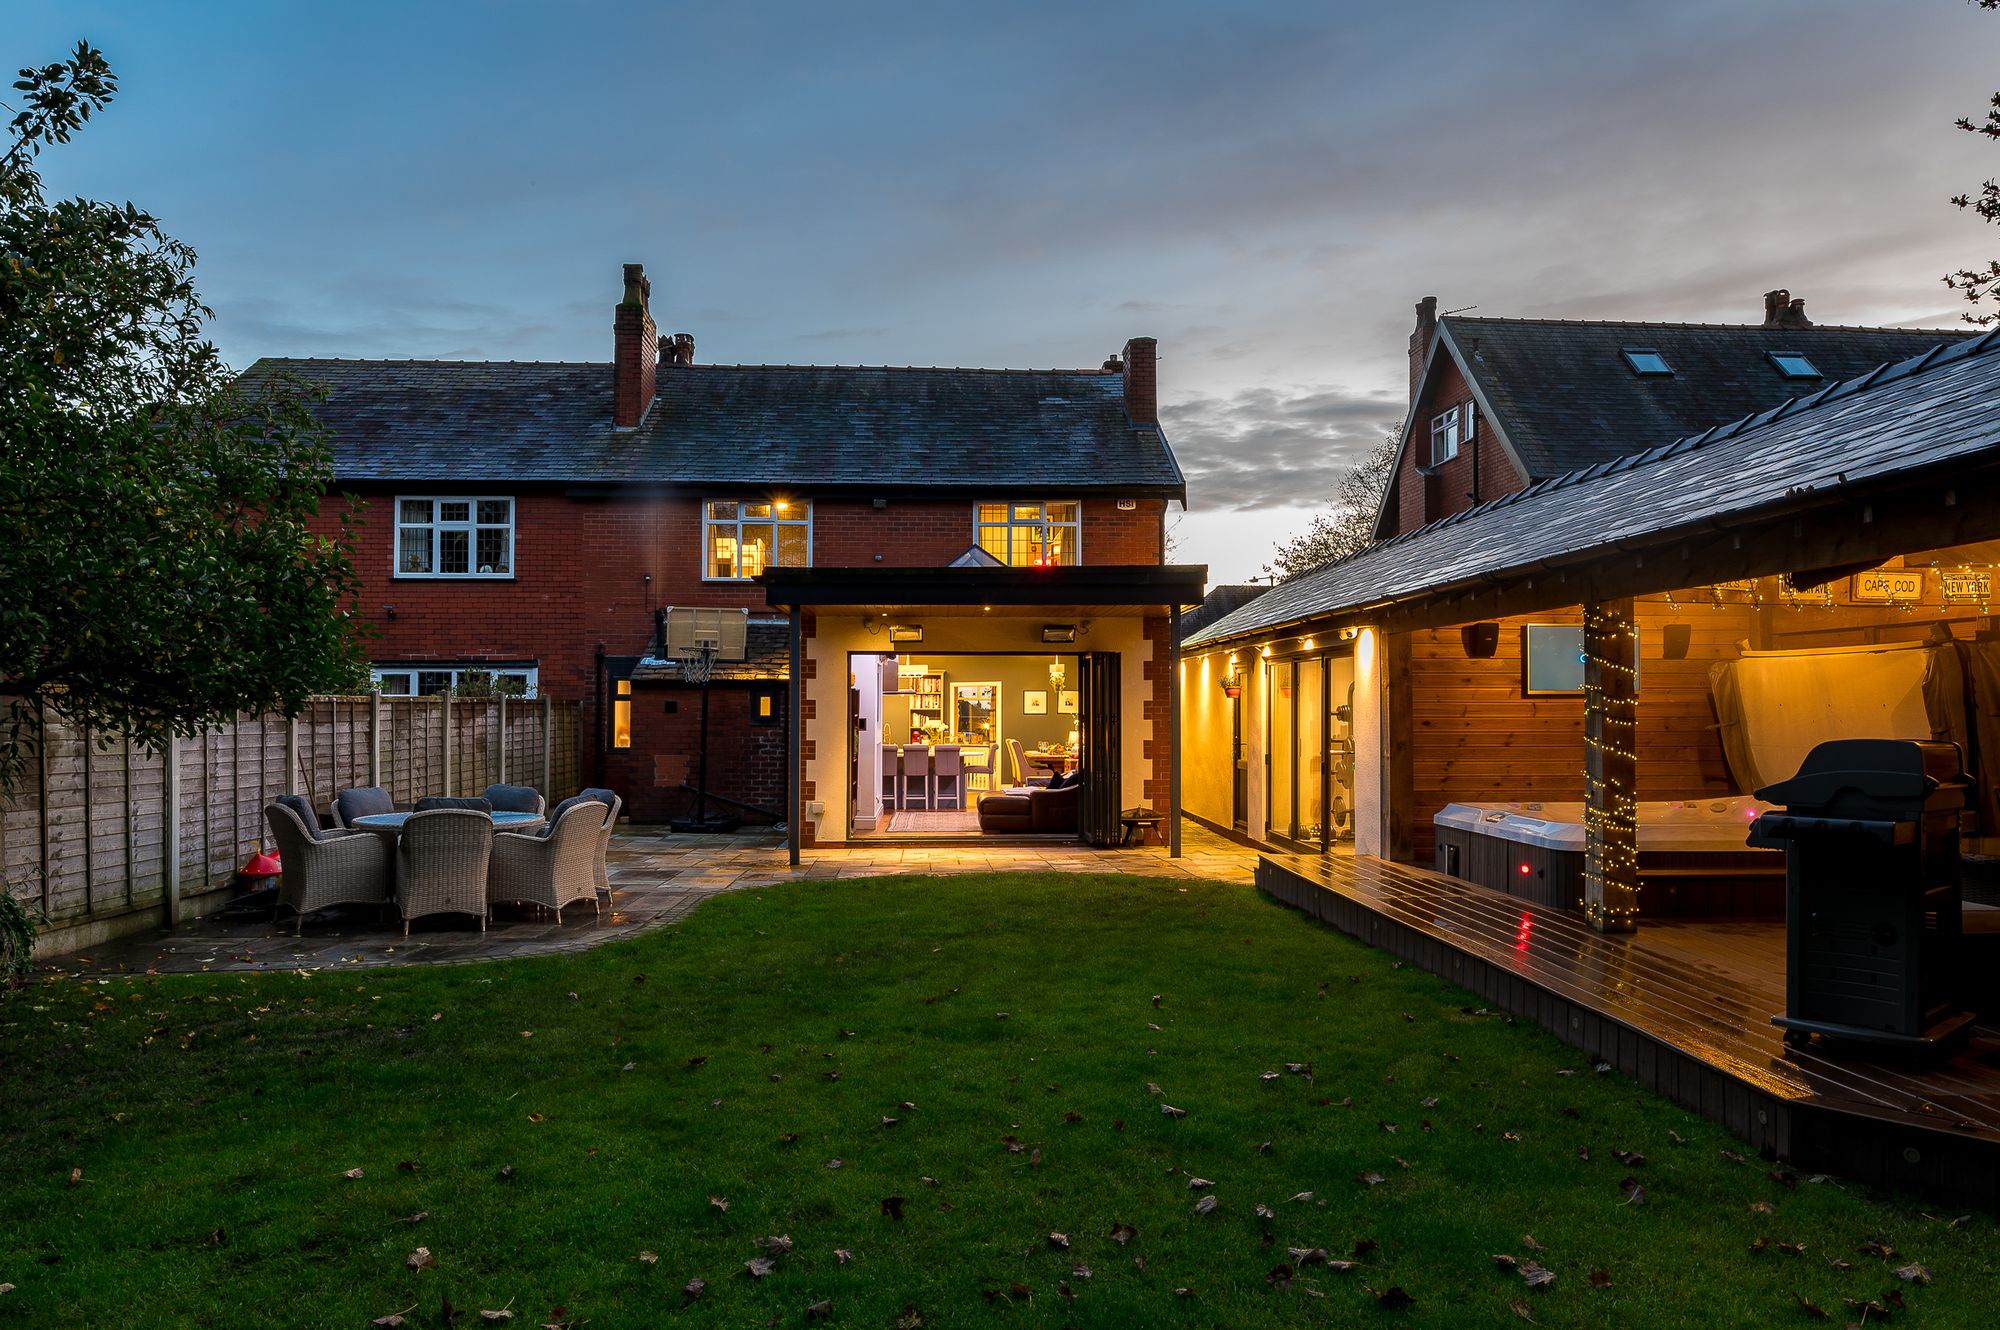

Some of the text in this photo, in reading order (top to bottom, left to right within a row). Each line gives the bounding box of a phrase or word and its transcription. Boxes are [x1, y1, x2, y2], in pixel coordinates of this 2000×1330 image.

[1864, 579, 1915, 593] CAPE COD
[1944, 581, 1989, 593] NEW YORK
